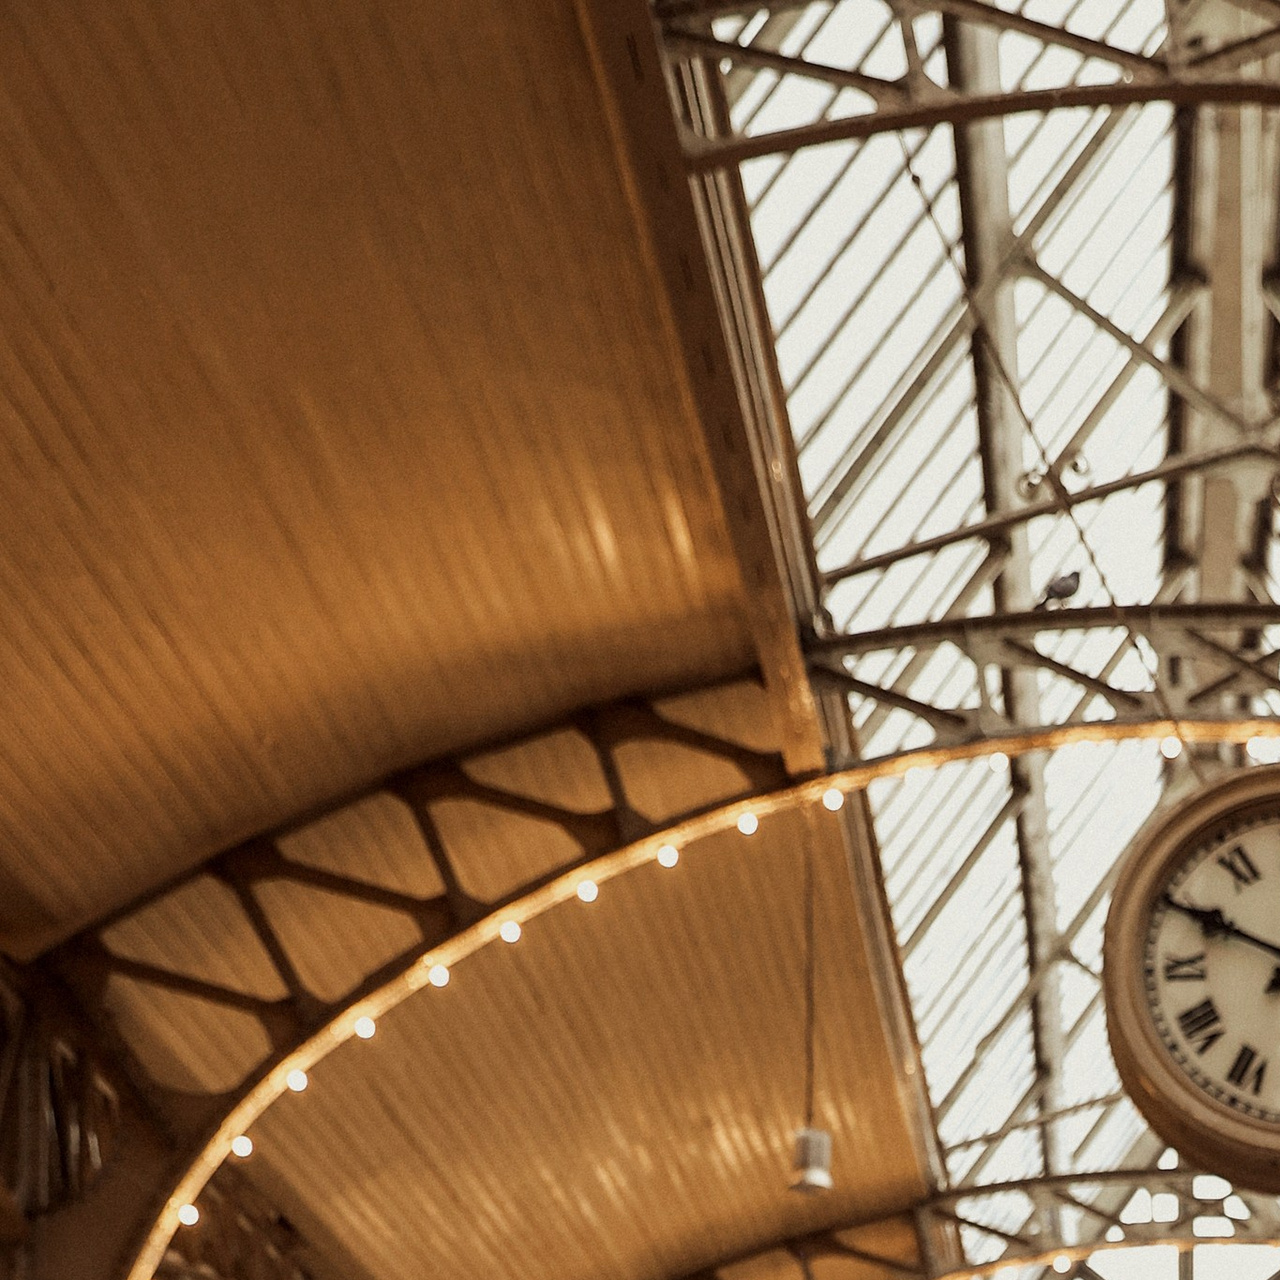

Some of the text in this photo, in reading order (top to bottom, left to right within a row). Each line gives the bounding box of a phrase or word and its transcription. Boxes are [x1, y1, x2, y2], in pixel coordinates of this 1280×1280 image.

[1216, 846, 1261, 892] XI
[1164, 952, 1206, 982] IX
[1177, 998, 1226, 1056] VIII
[1226, 1045, 1268, 1096] VII
